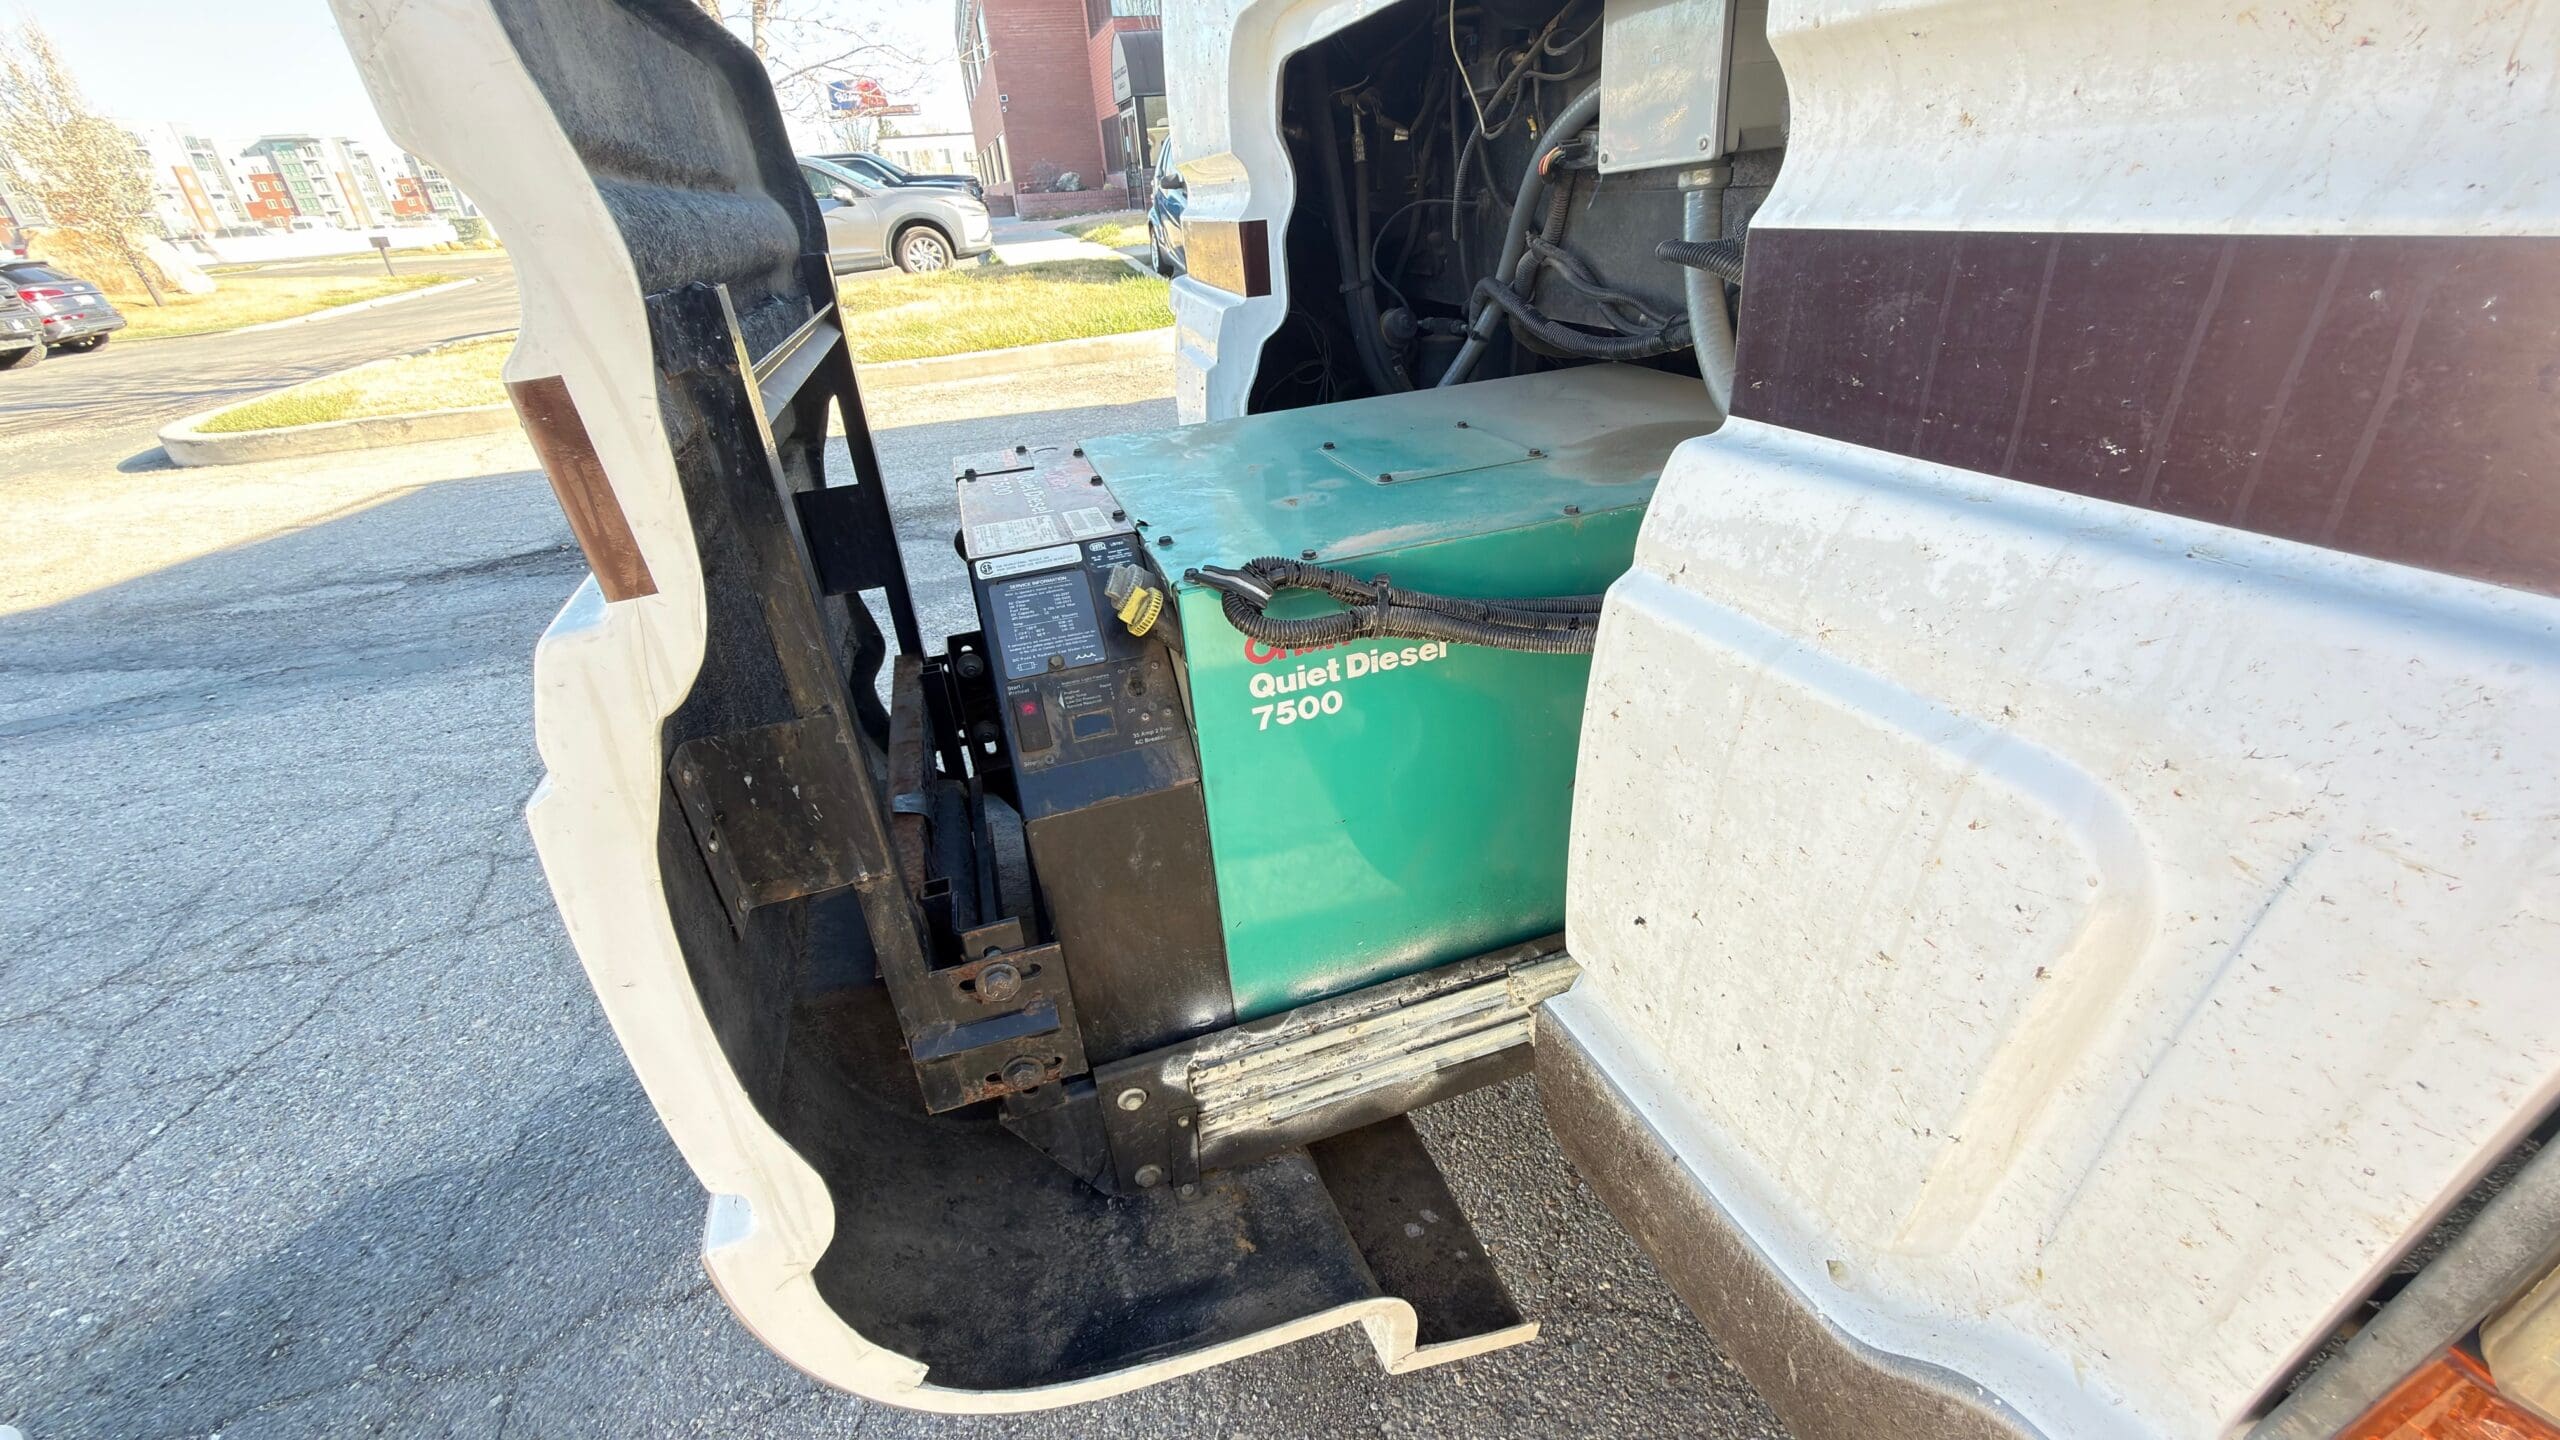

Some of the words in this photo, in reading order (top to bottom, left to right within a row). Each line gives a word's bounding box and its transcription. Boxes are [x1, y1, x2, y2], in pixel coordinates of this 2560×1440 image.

[1009, 582, 1031, 590] SERVICE
[1031, 576, 1067, 586] INFORMATION
[1249, 658, 1341, 698] Quiet
[1346, 640, 1449, 679] Diesel
[1252, 690, 1343, 731] 7500
